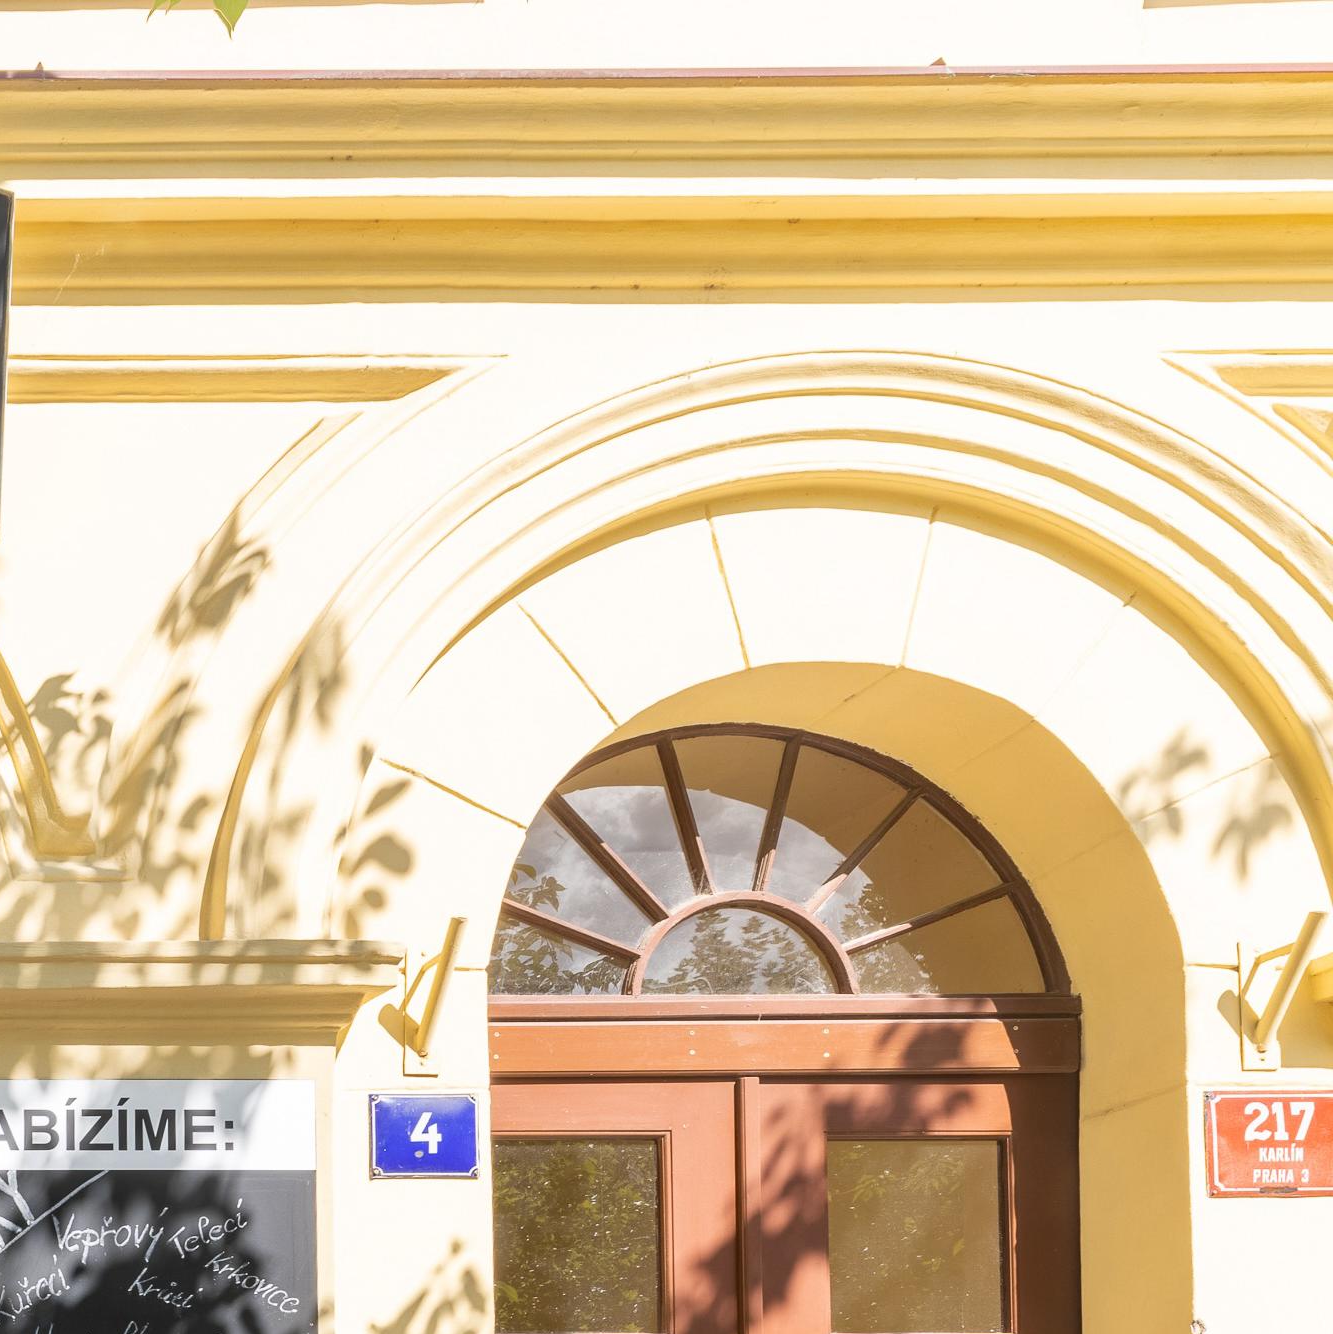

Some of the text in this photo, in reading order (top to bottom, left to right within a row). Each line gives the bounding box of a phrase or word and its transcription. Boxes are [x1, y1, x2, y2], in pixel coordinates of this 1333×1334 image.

[410, 1111, 442, 1154] 4
[1244, 1101, 1315, 1141] 217
[1259, 1143, 1304, 1162] KARLÍN
[1253, 1168, 1294, 1184] PRAHA
[52, 1198, 248, 1264] Vepřový Telecí
